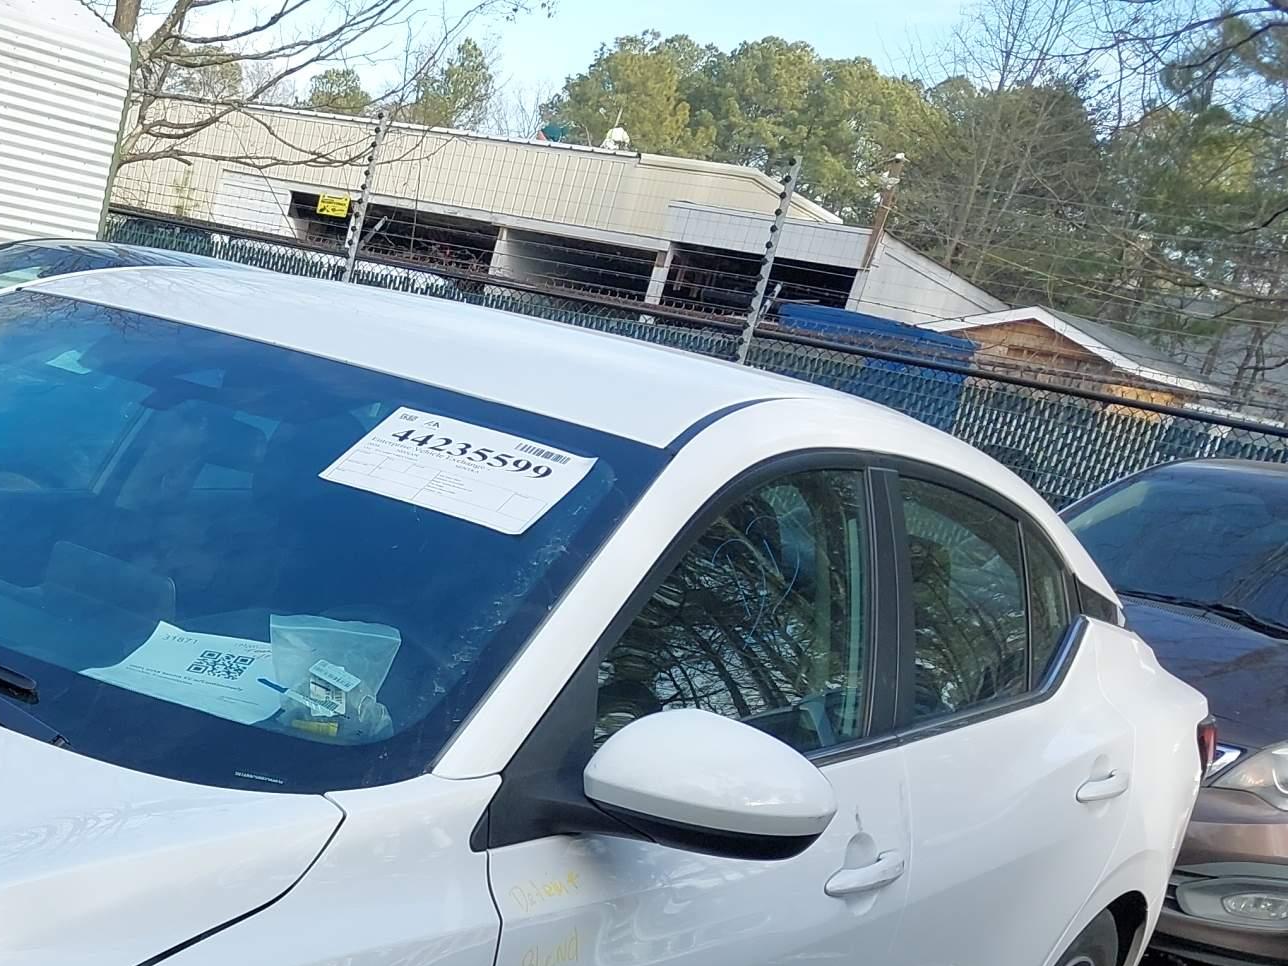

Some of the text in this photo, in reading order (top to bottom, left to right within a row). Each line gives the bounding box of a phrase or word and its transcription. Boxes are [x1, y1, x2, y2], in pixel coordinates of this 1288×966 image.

[392, 429, 552, 478] 44235599
[415, 446, 446, 459] Vehicle
[447, 455, 486, 470] Exchange
